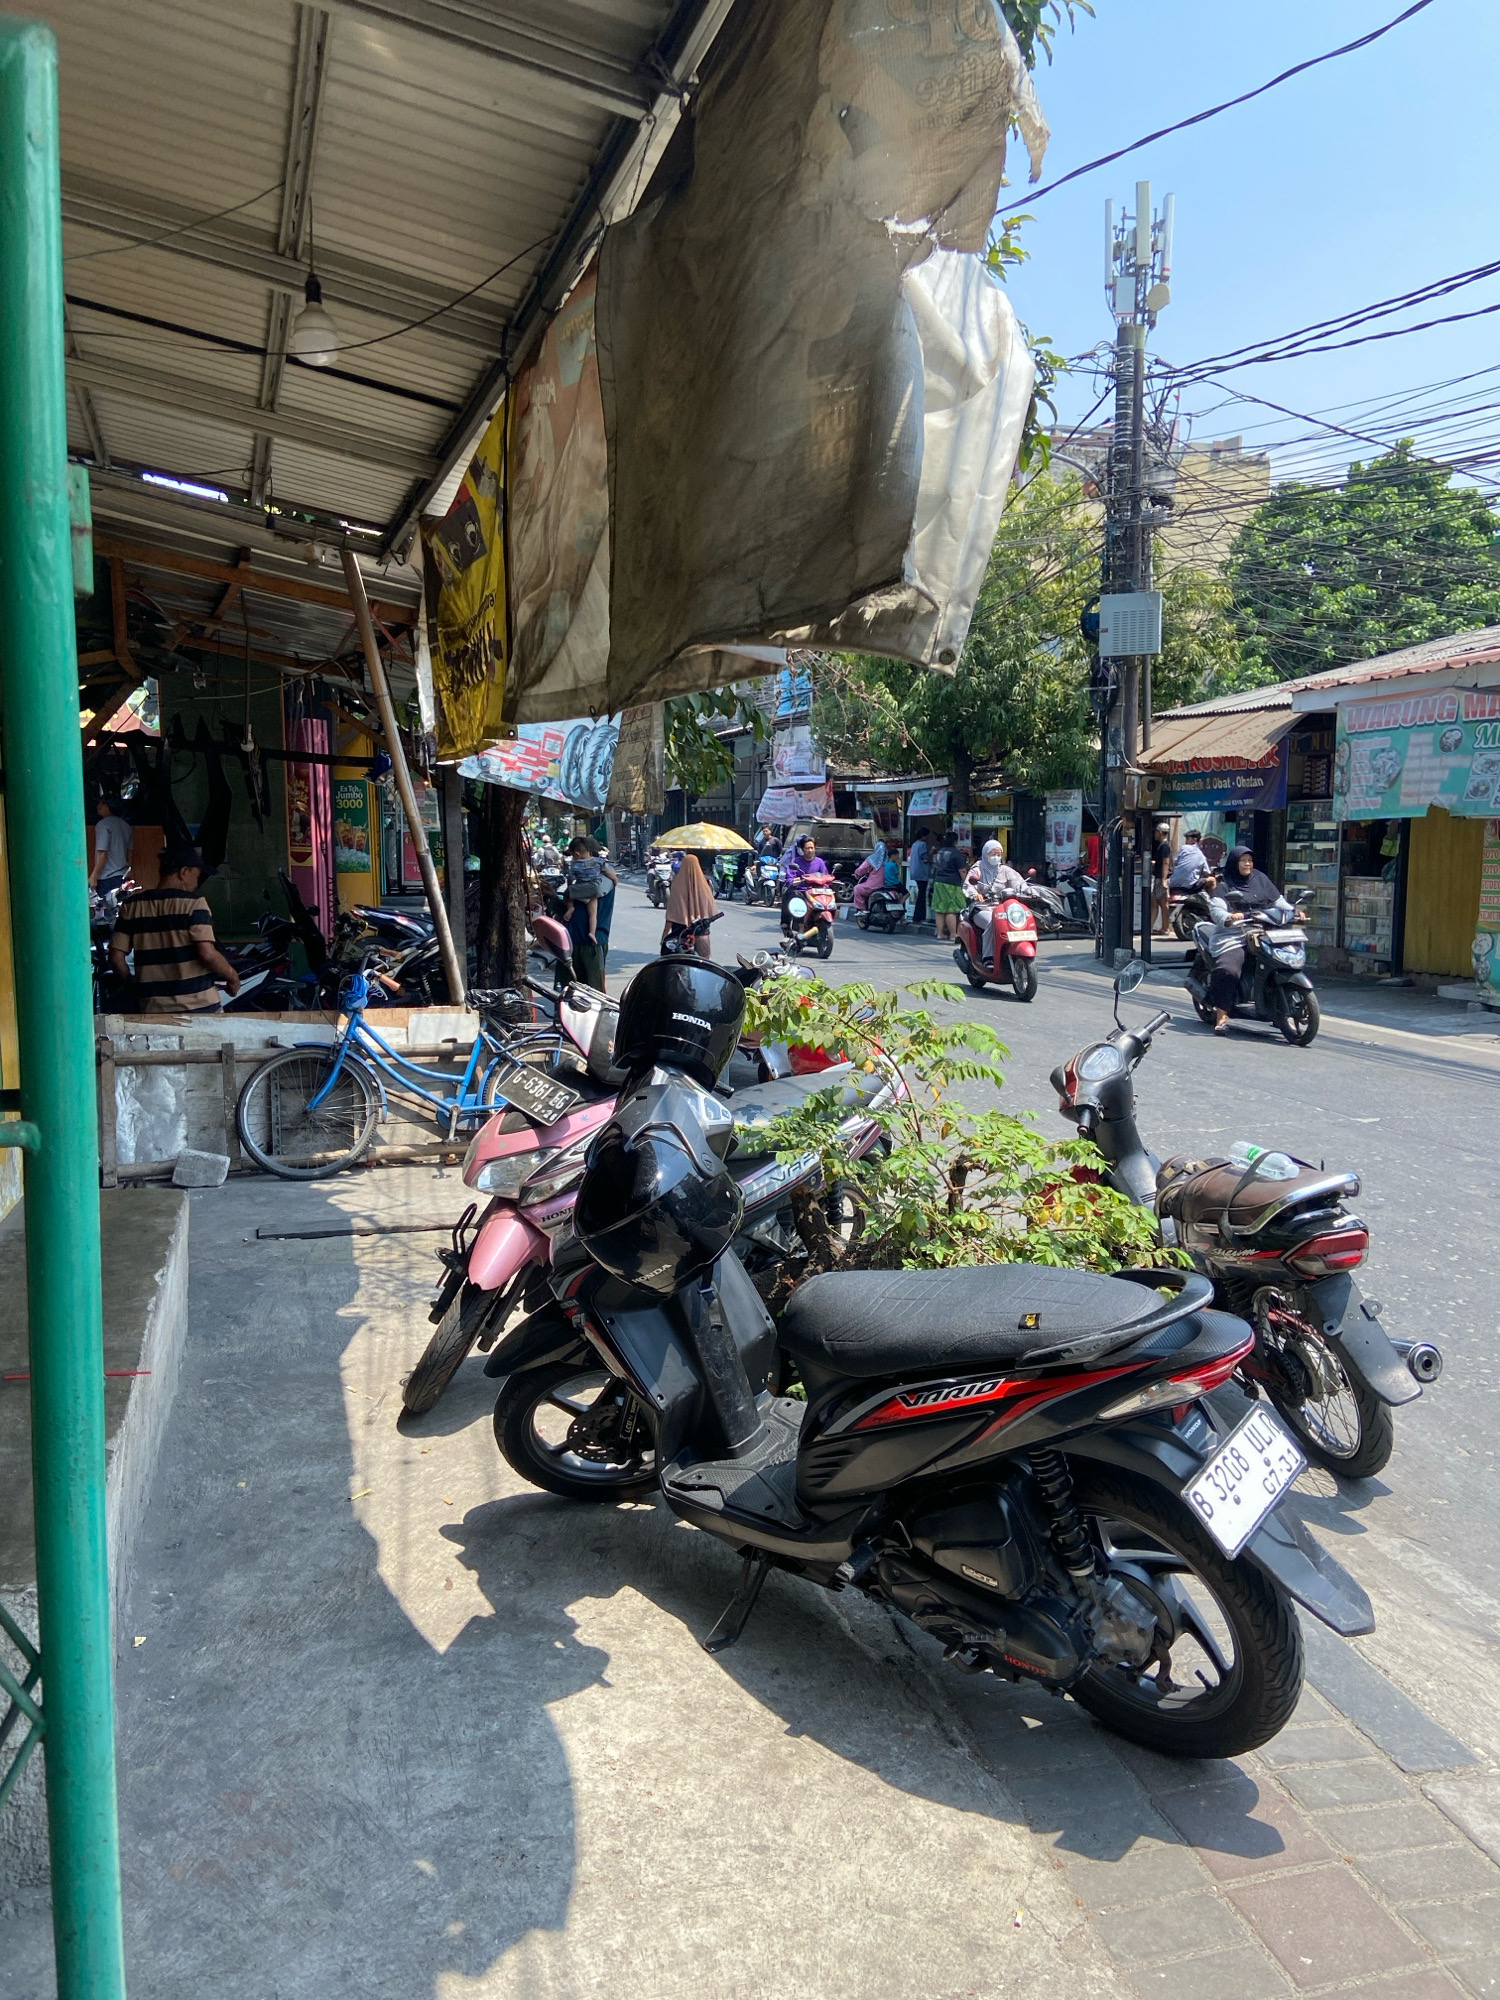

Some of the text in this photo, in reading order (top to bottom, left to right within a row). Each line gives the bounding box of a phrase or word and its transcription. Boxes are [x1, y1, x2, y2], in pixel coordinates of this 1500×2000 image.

[1346, 693, 1459, 733] WARUNG
[1172, 777, 1203, 791] Kosmetik
[1213, 776, 1231, 790] Obat
[1236, 775, 1264, 788] Obatan
[336, 791, 363, 799] Jumbo
[336, 799, 363, 808] 3000
[672, 1012, 712, 1031] HONDA
[549, 1090, 570, 1109] EG
[542, 1207, 574, 1222] HON
[632, 1264, 673, 1283] HONDA
[896, 1377, 1006, 1410] VARIO
[1184, 1419, 1202, 1439] HONDA
[1192, 1490, 1214, 1520] B
[1205, 1446, 1250, 1501] 3208
[1004, 1654, 1047, 1675] HONDA
